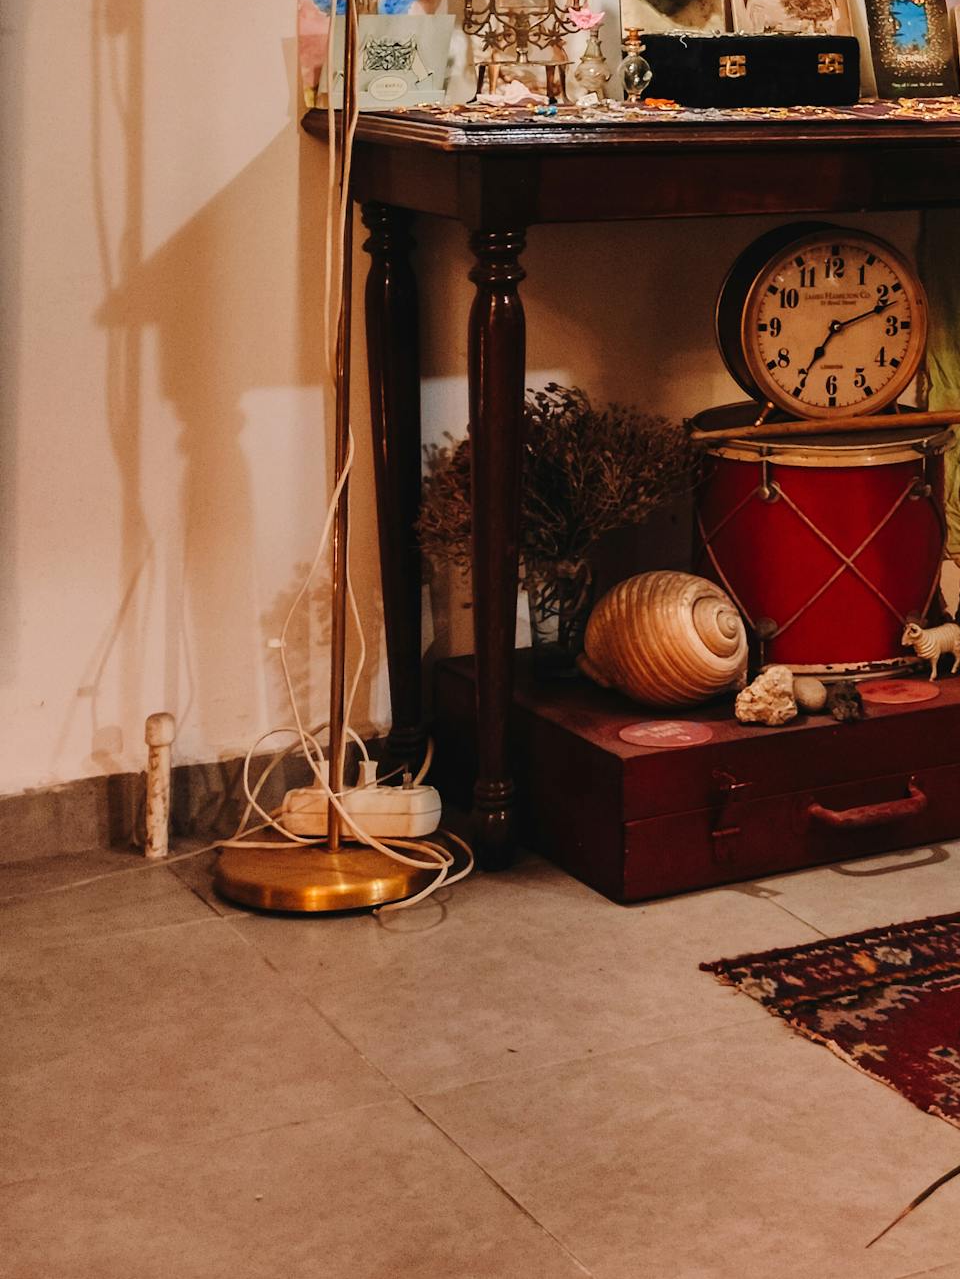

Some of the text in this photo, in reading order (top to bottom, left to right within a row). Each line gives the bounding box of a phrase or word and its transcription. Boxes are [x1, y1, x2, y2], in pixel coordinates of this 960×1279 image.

[799, 266, 815, 288] 11
[824, 258, 845, 278] 12
[857, 265, 865, 285] 1
[779, 288, 799, 309] 10
[876, 284, 889, 305] 2
[769, 317, 781, 337] 9
[885, 316, 898, 336] 3
[777, 348, 790, 368] 8
[874, 346, 888, 367] 4
[798, 369, 808, 388] 7
[825, 375, 837, 395] 6
[854, 368, 866, 387] 5
